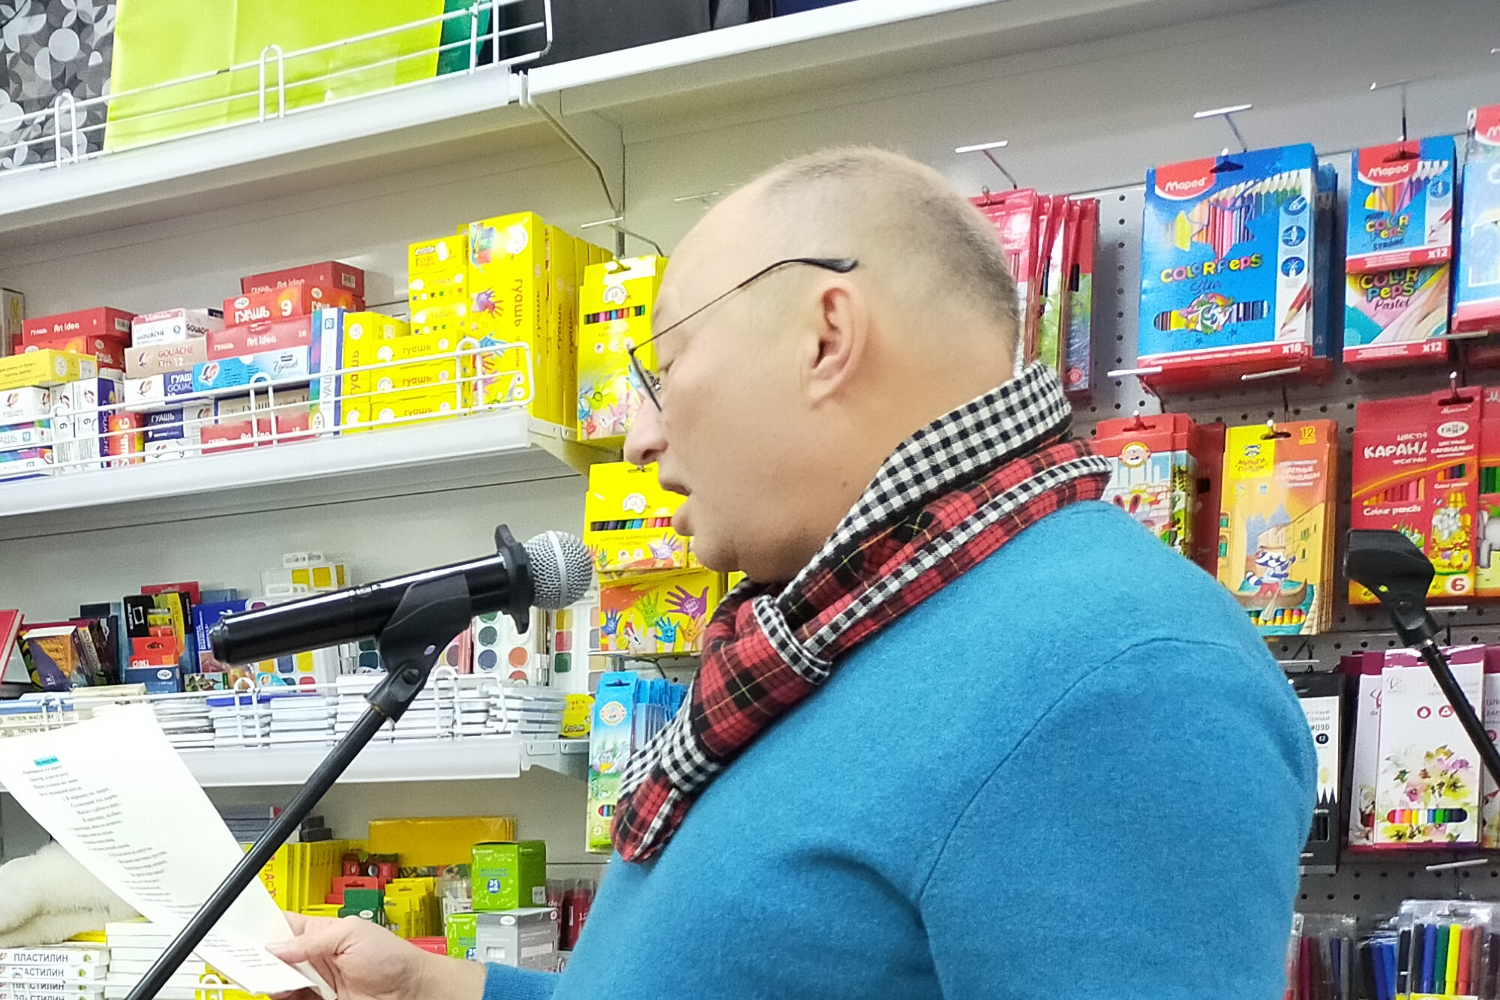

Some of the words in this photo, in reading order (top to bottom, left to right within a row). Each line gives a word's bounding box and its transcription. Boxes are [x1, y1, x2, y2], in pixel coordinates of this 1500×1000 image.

[1368, 163, 1409, 178] Maped
[1165, 175, 1207, 194] Maped
[512, 279, 523, 327] гуашь
[1374, 298, 1411, 316] Pastel
[234, 305, 271, 324] ГУАШЬ
[280, 299, 293, 316] 9
[53, 324, 64, 333] Art
[158, 347, 194, 358] GOUACHE
[402, 345, 431, 355] гуашь
[1422, 342, 1442, 353] x12
[402, 375, 432, 387] гуашь
[151, 411, 175, 422] ГУАШЬ
[404, 406, 433, 417] гуашь
[1302, 427, 1315, 438] 12
[1363, 506, 1391, 516] Colour
[1392, 504, 1422, 516] pencils
[1450, 577, 1466, 592] 6
[13, 953, 69, 963] ПЛАСТИЛИН
[11, 967, 64, 978] АСТИЛИН
